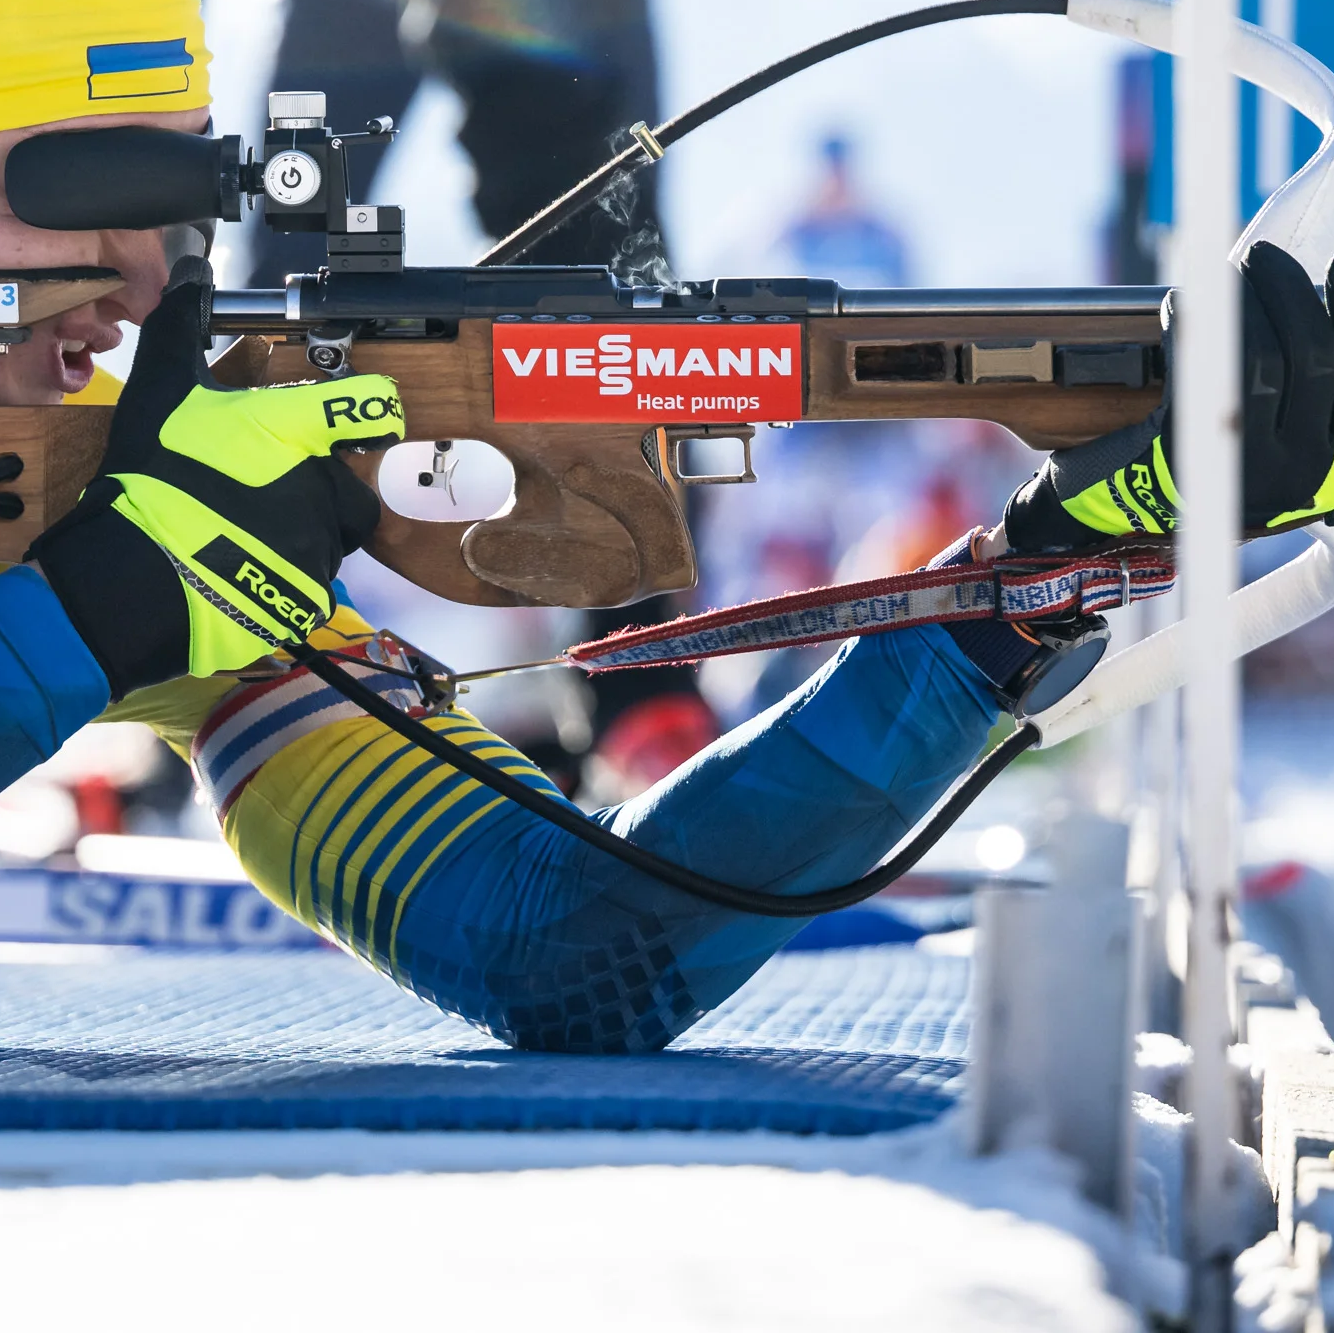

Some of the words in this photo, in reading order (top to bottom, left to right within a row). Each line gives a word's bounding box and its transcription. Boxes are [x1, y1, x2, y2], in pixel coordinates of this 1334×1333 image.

[501, 334, 792, 396] VIESSMANN
[637, 394, 684, 410] Heat
[691, 396, 760, 413] pumps
[55, 878, 289, 944] SALO
